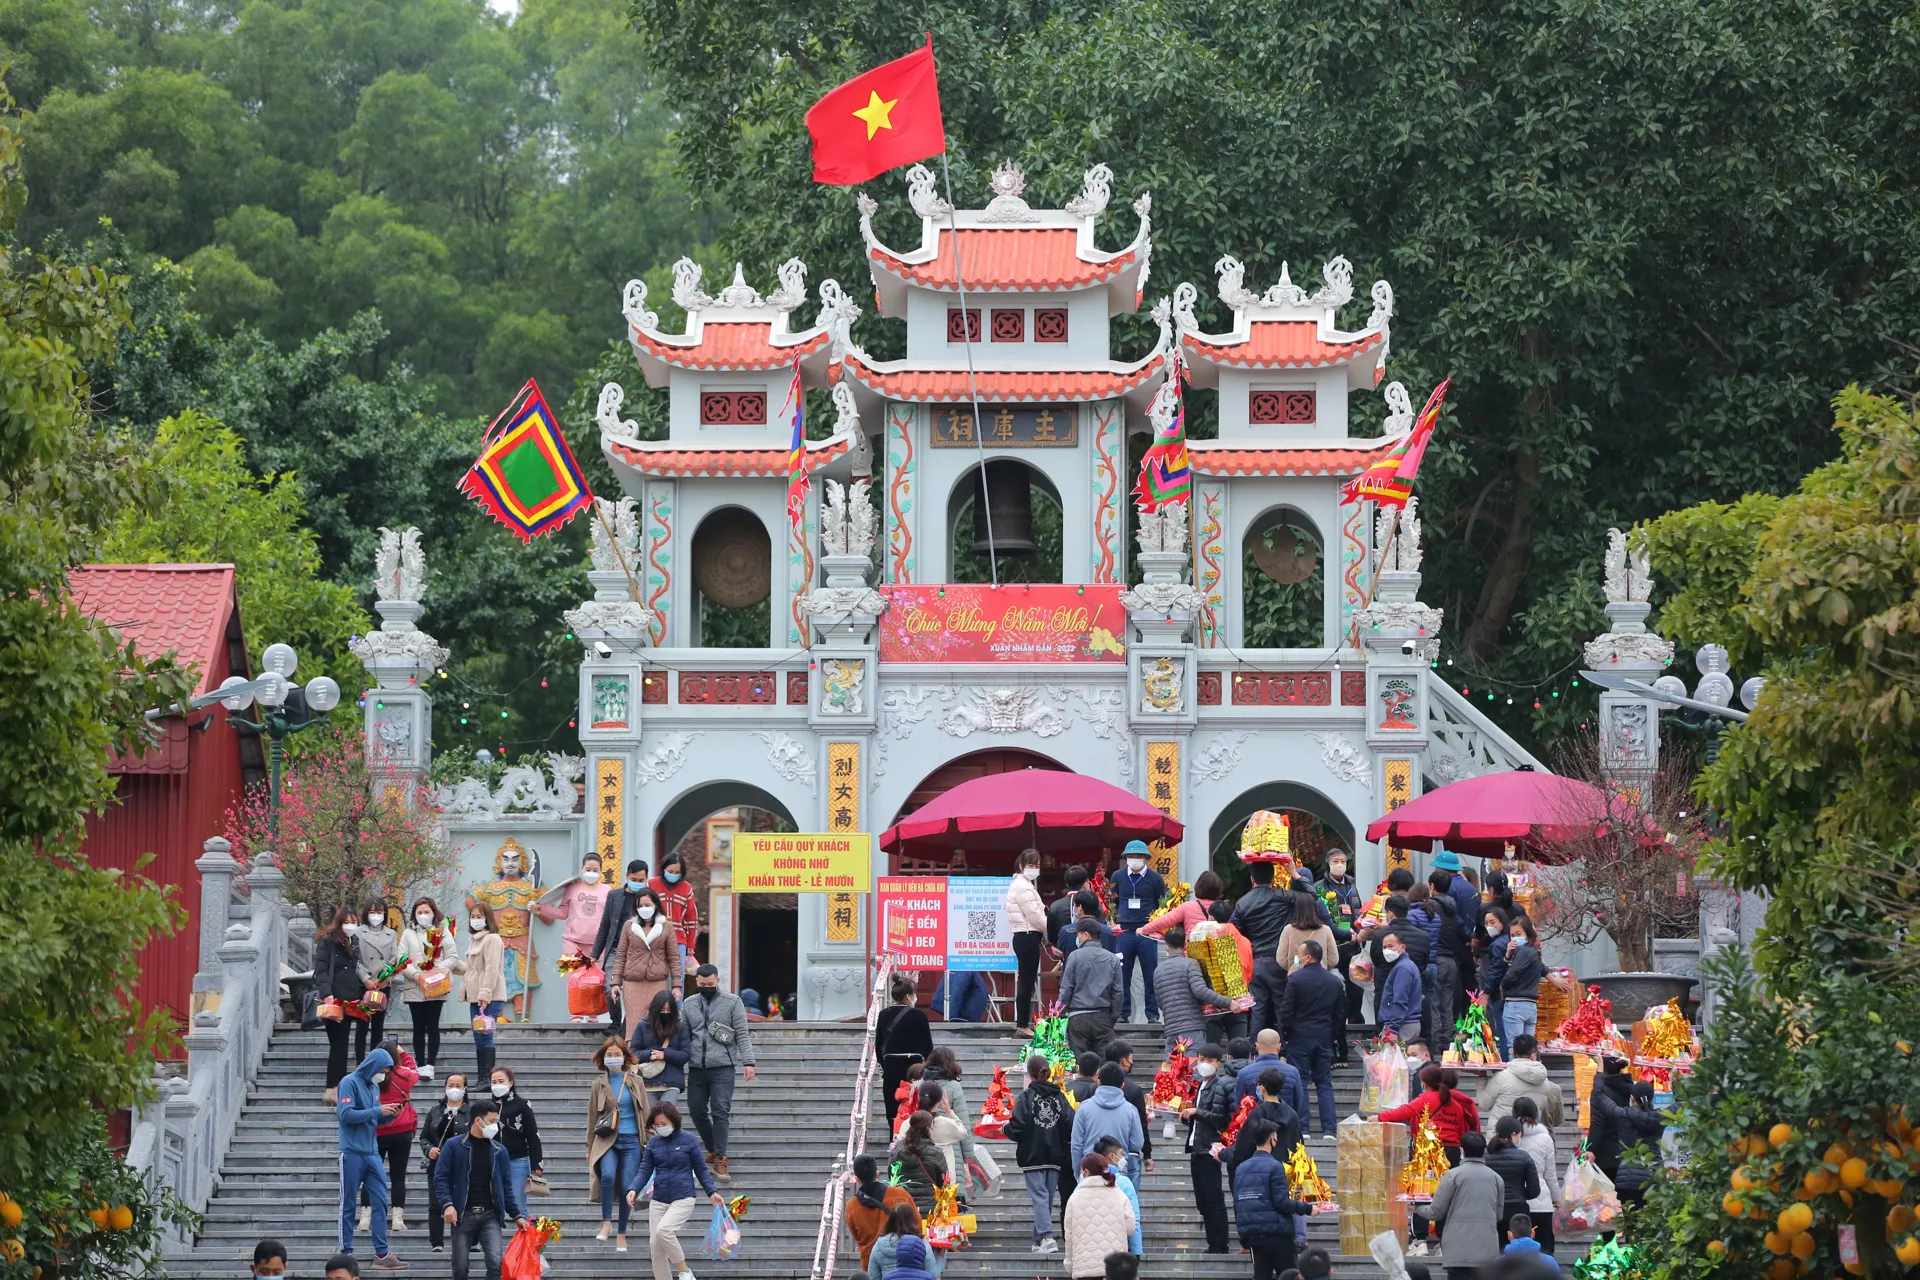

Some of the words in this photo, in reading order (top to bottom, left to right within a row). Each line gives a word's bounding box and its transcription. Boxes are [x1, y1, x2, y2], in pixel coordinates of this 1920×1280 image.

[903, 606, 941, 633] Chúc
[1002, 606, 1045, 632] Năm
[753, 838, 771, 852] YÊU
[796, 838, 815, 852] QUÝ
[817, 838, 850, 852] KHÁCH
[773, 856, 806, 869] KHÔNG
[907, 897, 941, 911] KHÁCH
[911, 954, 944, 966] TRANG
